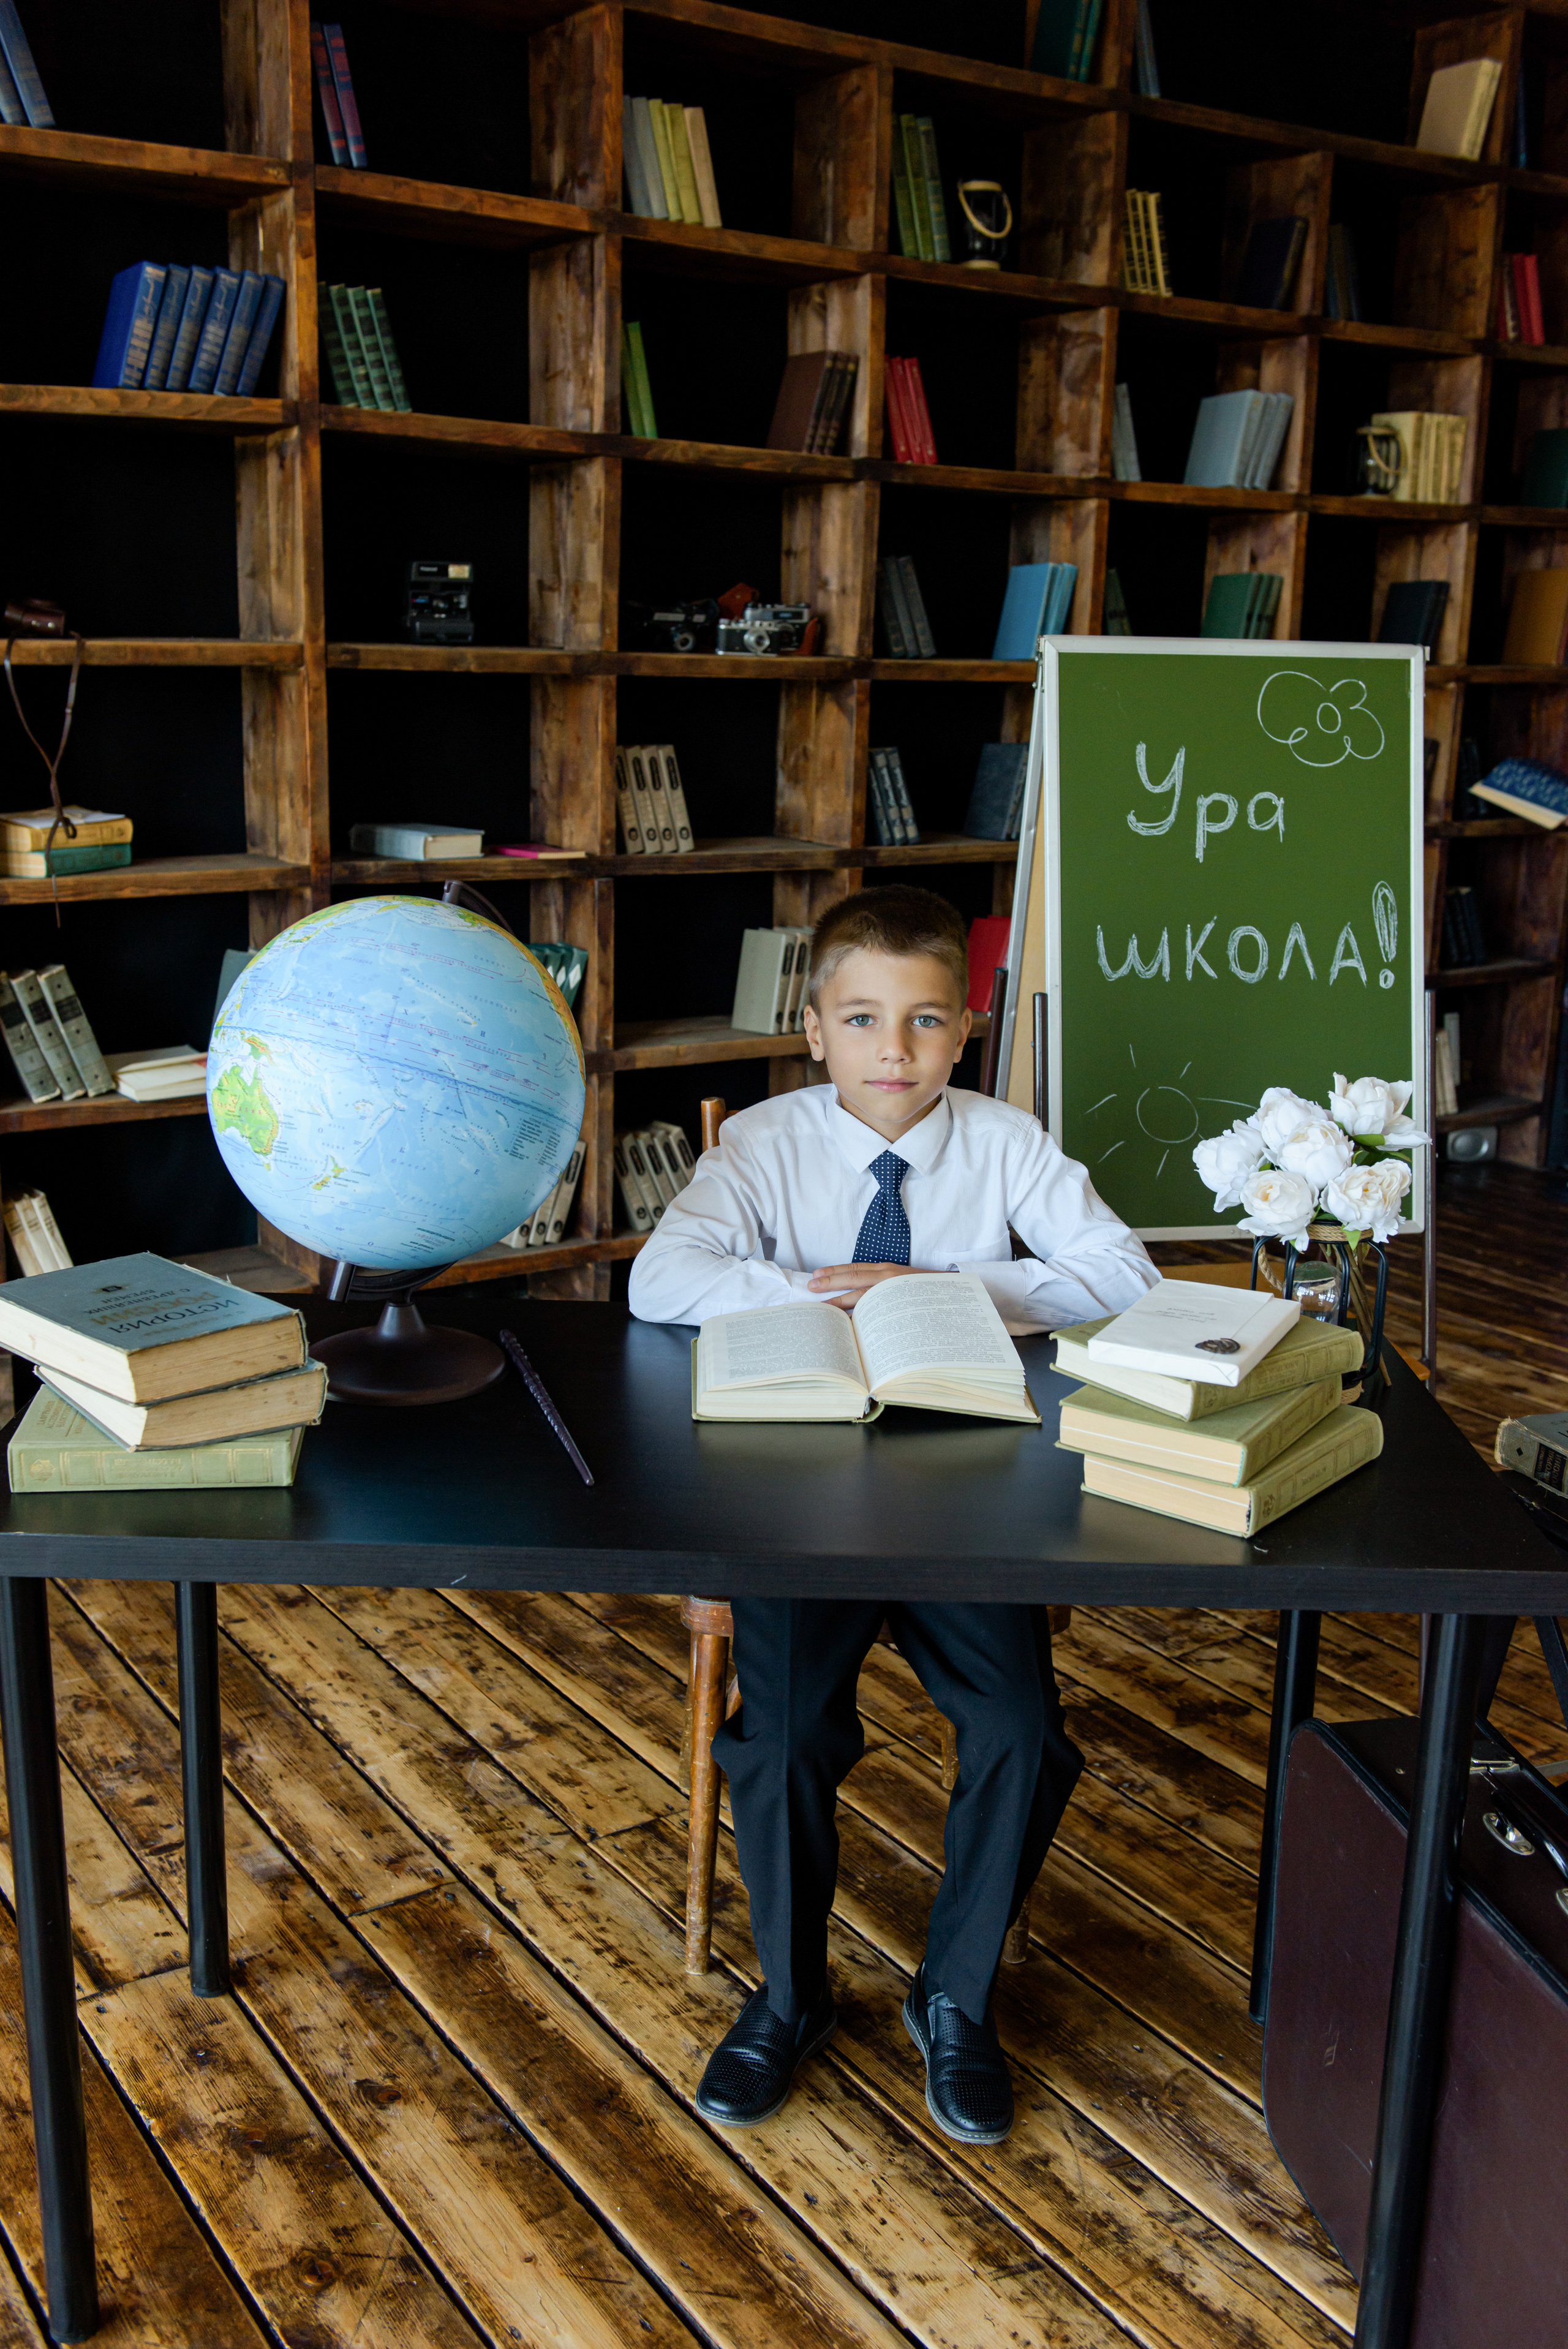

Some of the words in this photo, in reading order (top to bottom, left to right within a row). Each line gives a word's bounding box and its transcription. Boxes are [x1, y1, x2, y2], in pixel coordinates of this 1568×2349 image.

[1127, 741, 1285, 863] Ура
[84, 1291, 176, 1315] ДРЕВНЕЙШИХ
[90, 1291, 220, 1325] РОССИИ
[101, 1289, 156, 1303] ВРЕМЕН
[108, 1299, 241, 1333] ИСТОРИЯ
[1544, 1449, 1555, 1485] ИТОРИЯ
